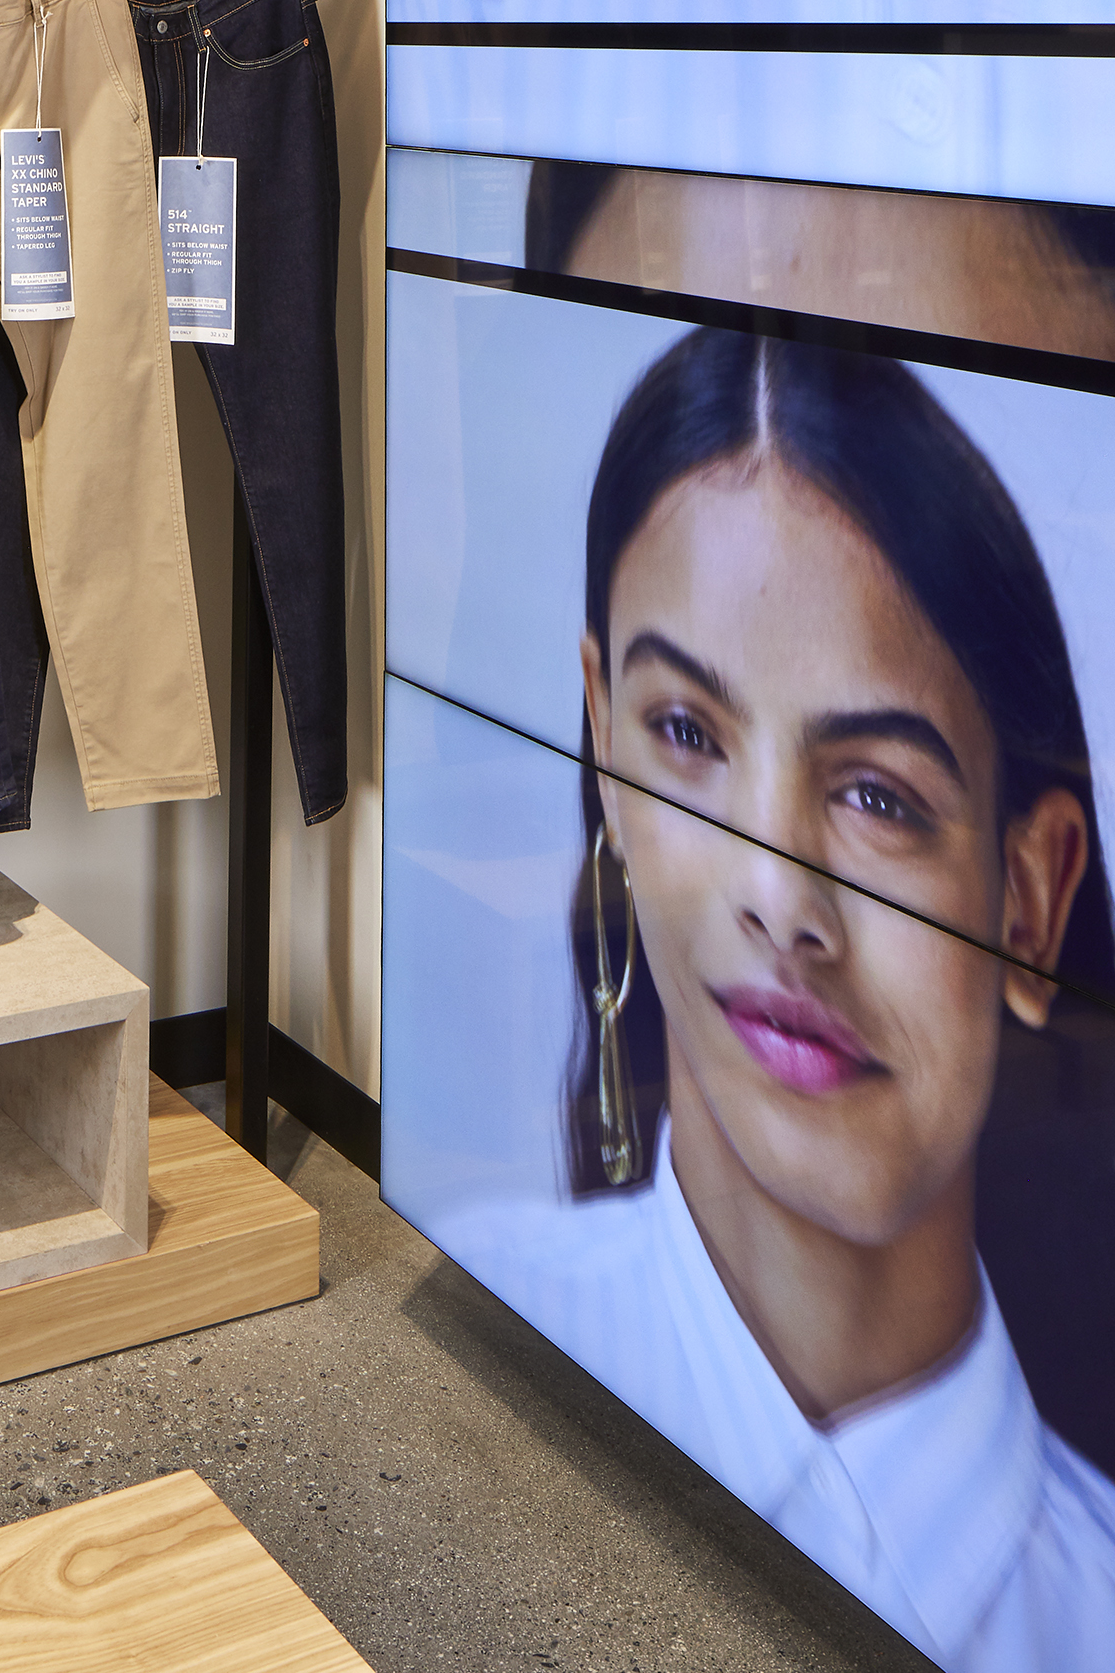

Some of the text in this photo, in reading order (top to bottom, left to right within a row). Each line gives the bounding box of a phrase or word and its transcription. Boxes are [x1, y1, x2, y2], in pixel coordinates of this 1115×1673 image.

[12, 155, 44, 165] LEVI'S
[12, 168, 58, 179] XX CHINO
[12, 182, 62, 193] STANDARD
[11, 197, 47, 207] TAPER
[168, 223, 224, 234] STRAIGHT
